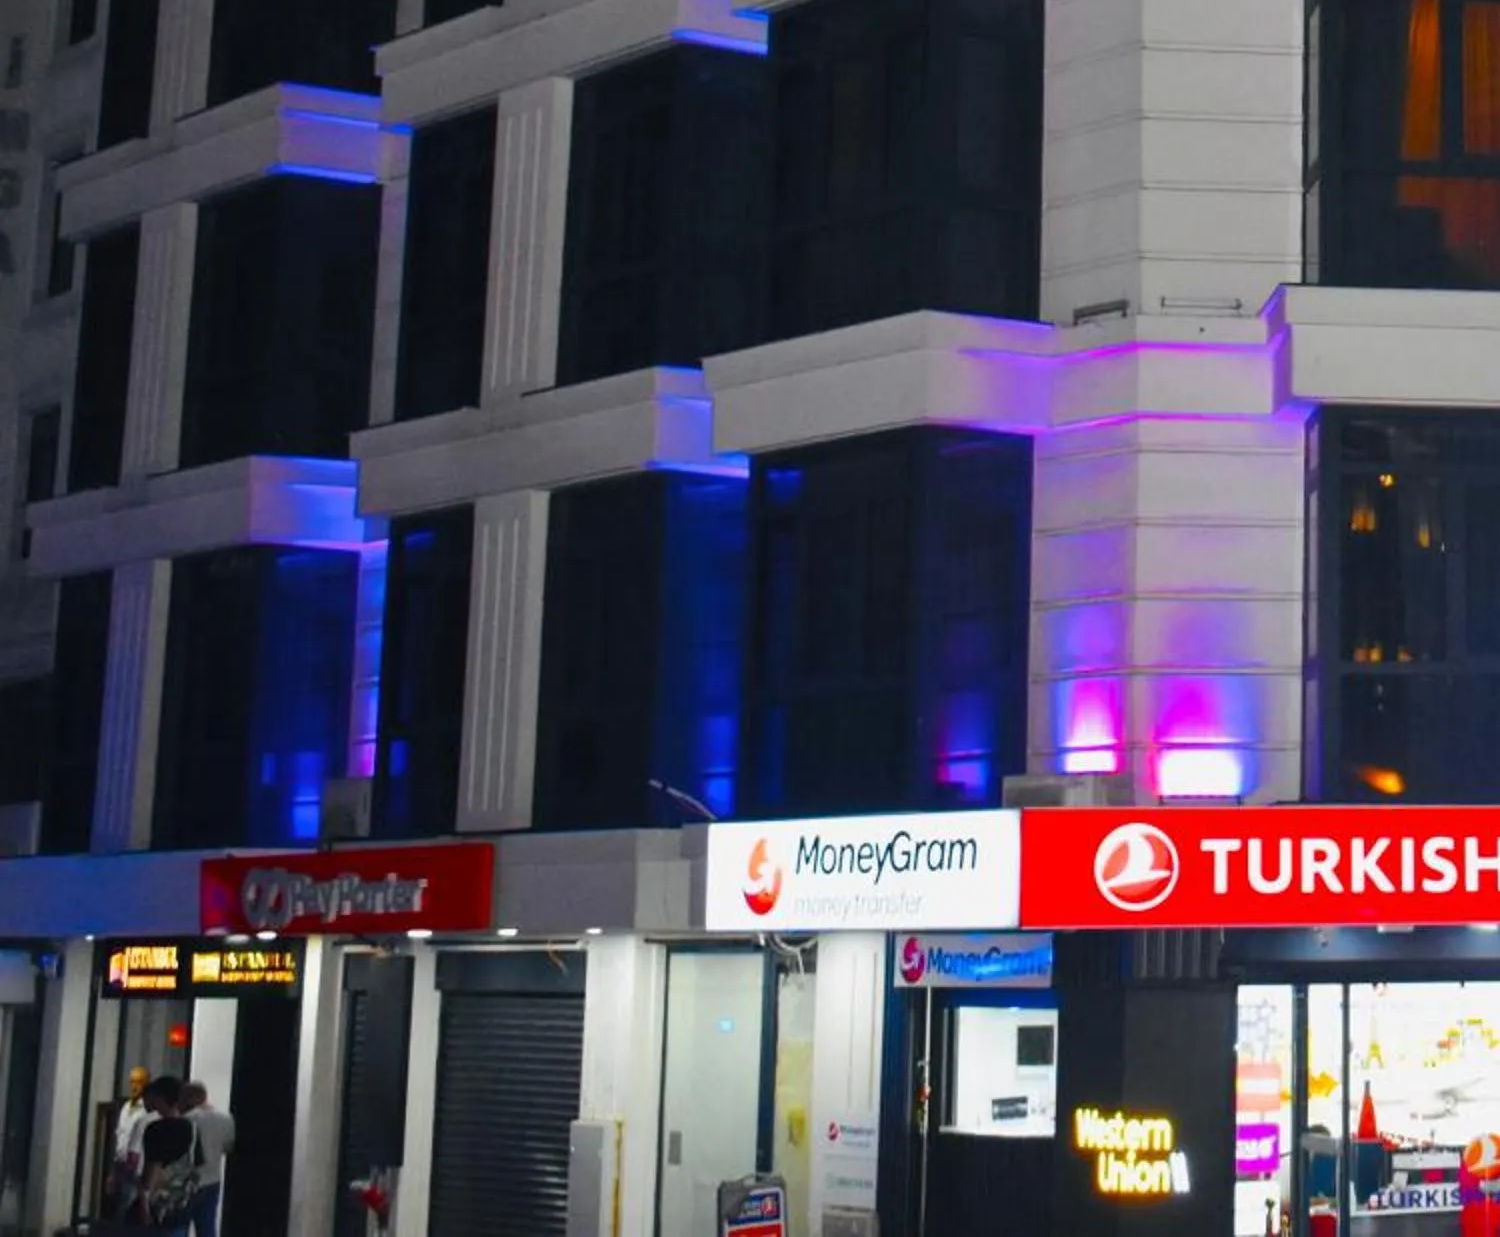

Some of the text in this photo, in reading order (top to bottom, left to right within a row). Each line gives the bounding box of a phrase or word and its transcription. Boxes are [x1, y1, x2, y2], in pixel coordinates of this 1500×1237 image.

[795, 830, 977, 884] MoneyGram
[1075, 1107, 1173, 1151] Western
[1098, 1149, 1170, 1194] Union
